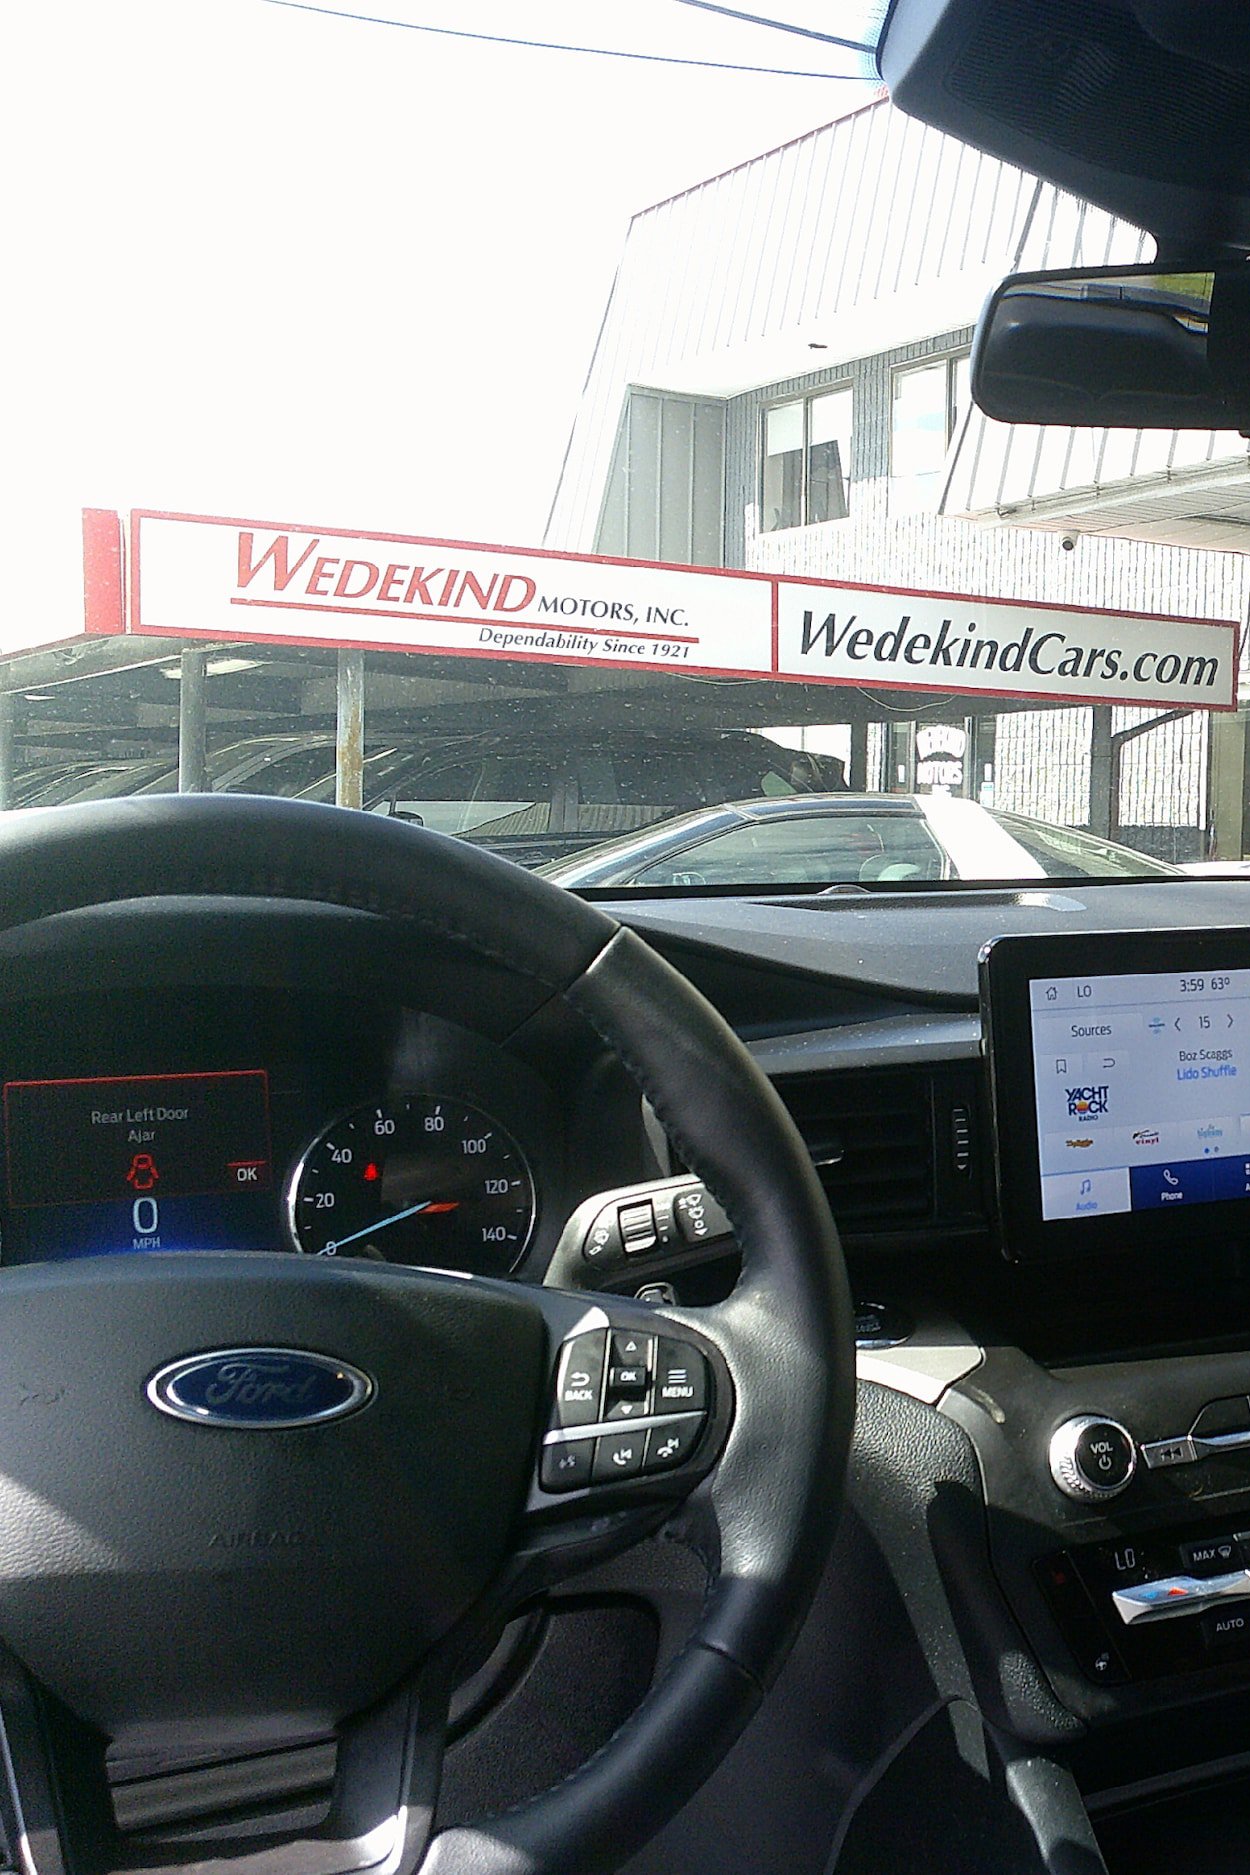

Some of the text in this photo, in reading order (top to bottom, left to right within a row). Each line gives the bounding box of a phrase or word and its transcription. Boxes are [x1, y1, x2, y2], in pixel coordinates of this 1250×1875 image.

[237, 531, 690, 627] WEDEKIND MOTORS, INC.
[479, 627, 691, 659] Dependability Since 1921
[800, 609, 1220, 688] WedekindCars.com
[1077, 984, 1092, 998] LO
[1180, 979, 1205, 993] 3:59
[1198, 1015, 1211, 1029] 15
[1071, 1024, 1112, 1037] Sources
[1179, 1048, 1233, 1062] Boz Scaggs
[1177, 1064, 1238, 1081] Lido Shuffle
[1065, 1086, 1109, 1102] YACHT
[91, 1107, 189, 1125] Rear Left Door
[424, 1116, 445, 1132] 80
[374, 1119, 396, 1135] 60
[127, 1129, 156, 1145] Ajar
[461, 1139, 487, 1155] 100
[331, 1148, 353, 1164] 40
[237, 1167, 258, 1182] OK
[484, 1178, 509, 1195] 120
[315, 1192, 335, 1209] 20
[1160, 1191, 1183, 1202] Phone
[1075, 1201, 1098, 1212] Audio
[132, 1196, 159, 1234] 0
[481, 1225, 507, 1243] 140
[133, 1236, 161, 1250] MPH
[205, 1362, 322, 1405] Ford
[620, 1370, 637, 1382] OK
[564, 1389, 594, 1402] BACK
[661, 1385, 695, 1398] MENU
[1089, 1442, 1114, 1455] VOL
[1192, 1548, 1217, 1563] MAX
[1216, 1617, 1245, 1632] AUTO
